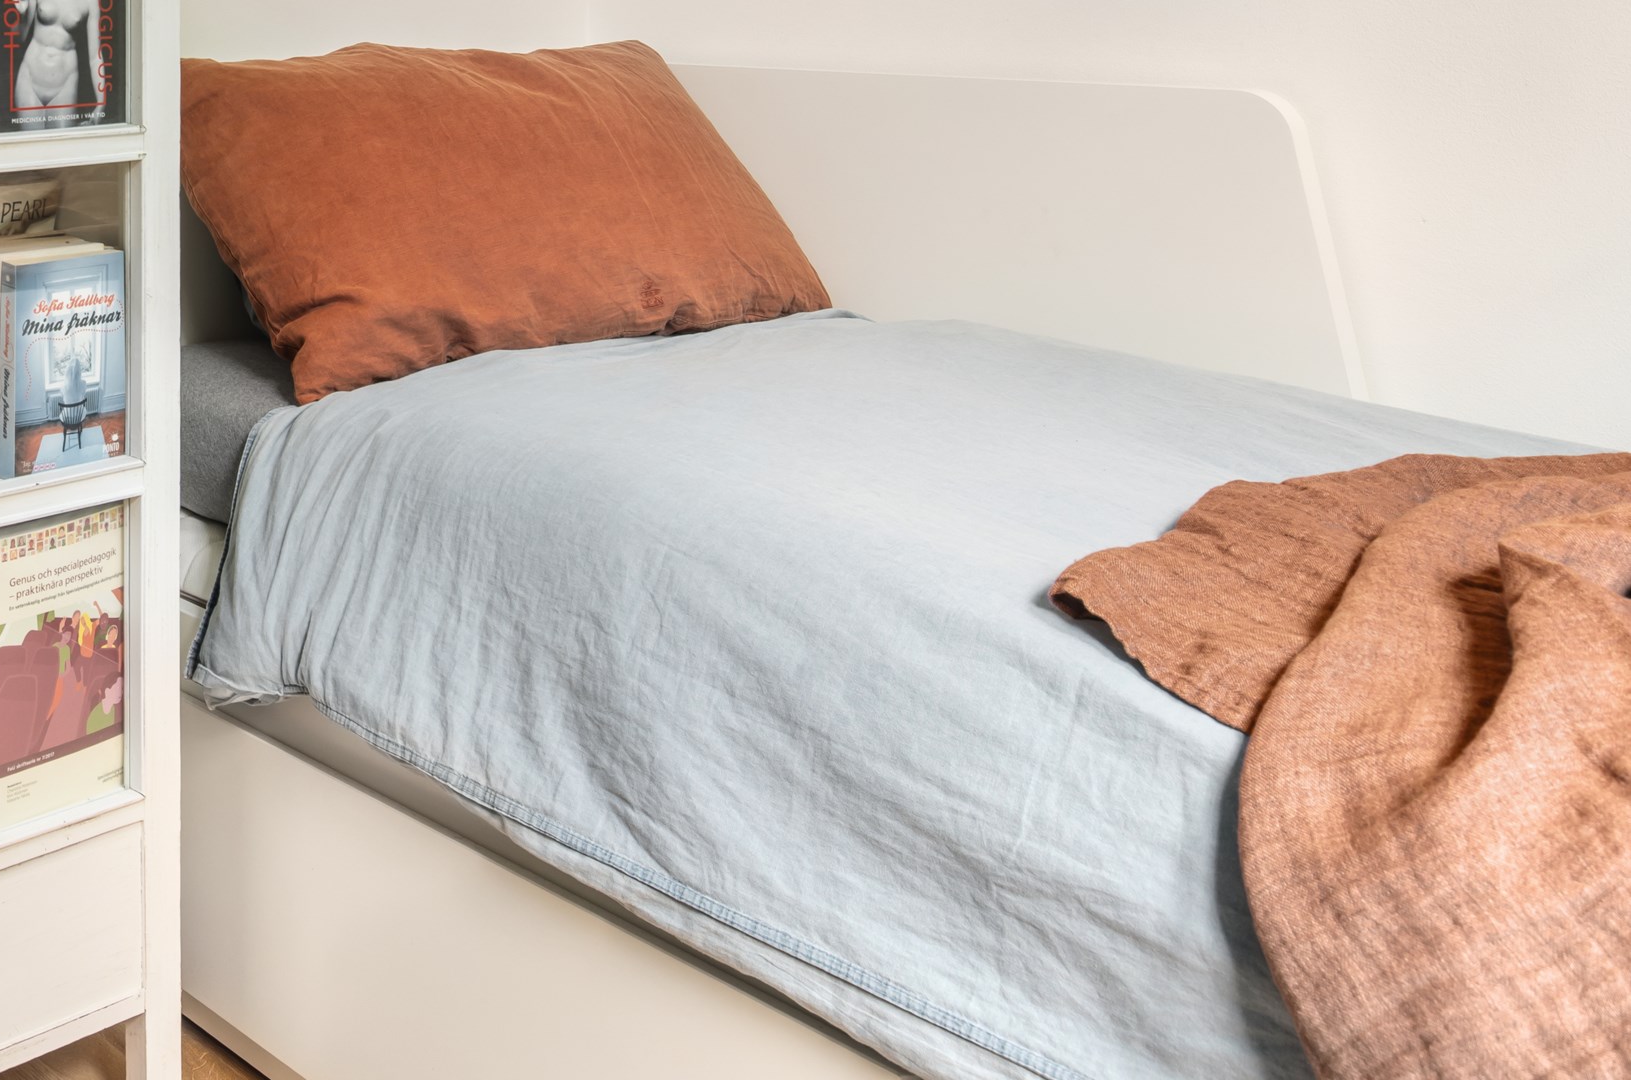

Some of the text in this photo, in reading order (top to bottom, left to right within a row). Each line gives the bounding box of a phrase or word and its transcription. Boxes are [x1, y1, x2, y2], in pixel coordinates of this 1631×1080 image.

[11, 111, 106, 124] MEDICINSKA DIAGNOSER VÅR TID
[0, 197, 49, 224] PEARL
[33, 294, 116, 317] Sofia Hallberg
[21, 310, 122, 336] Mina fräknar
[9, 547, 117, 588] Genus och specialpedagogik
[15, 565, 104, 601] praktiknära perspektiv
[15, 598, 41, 610] vetenskaplig
[58, 590, 66, 598] från
